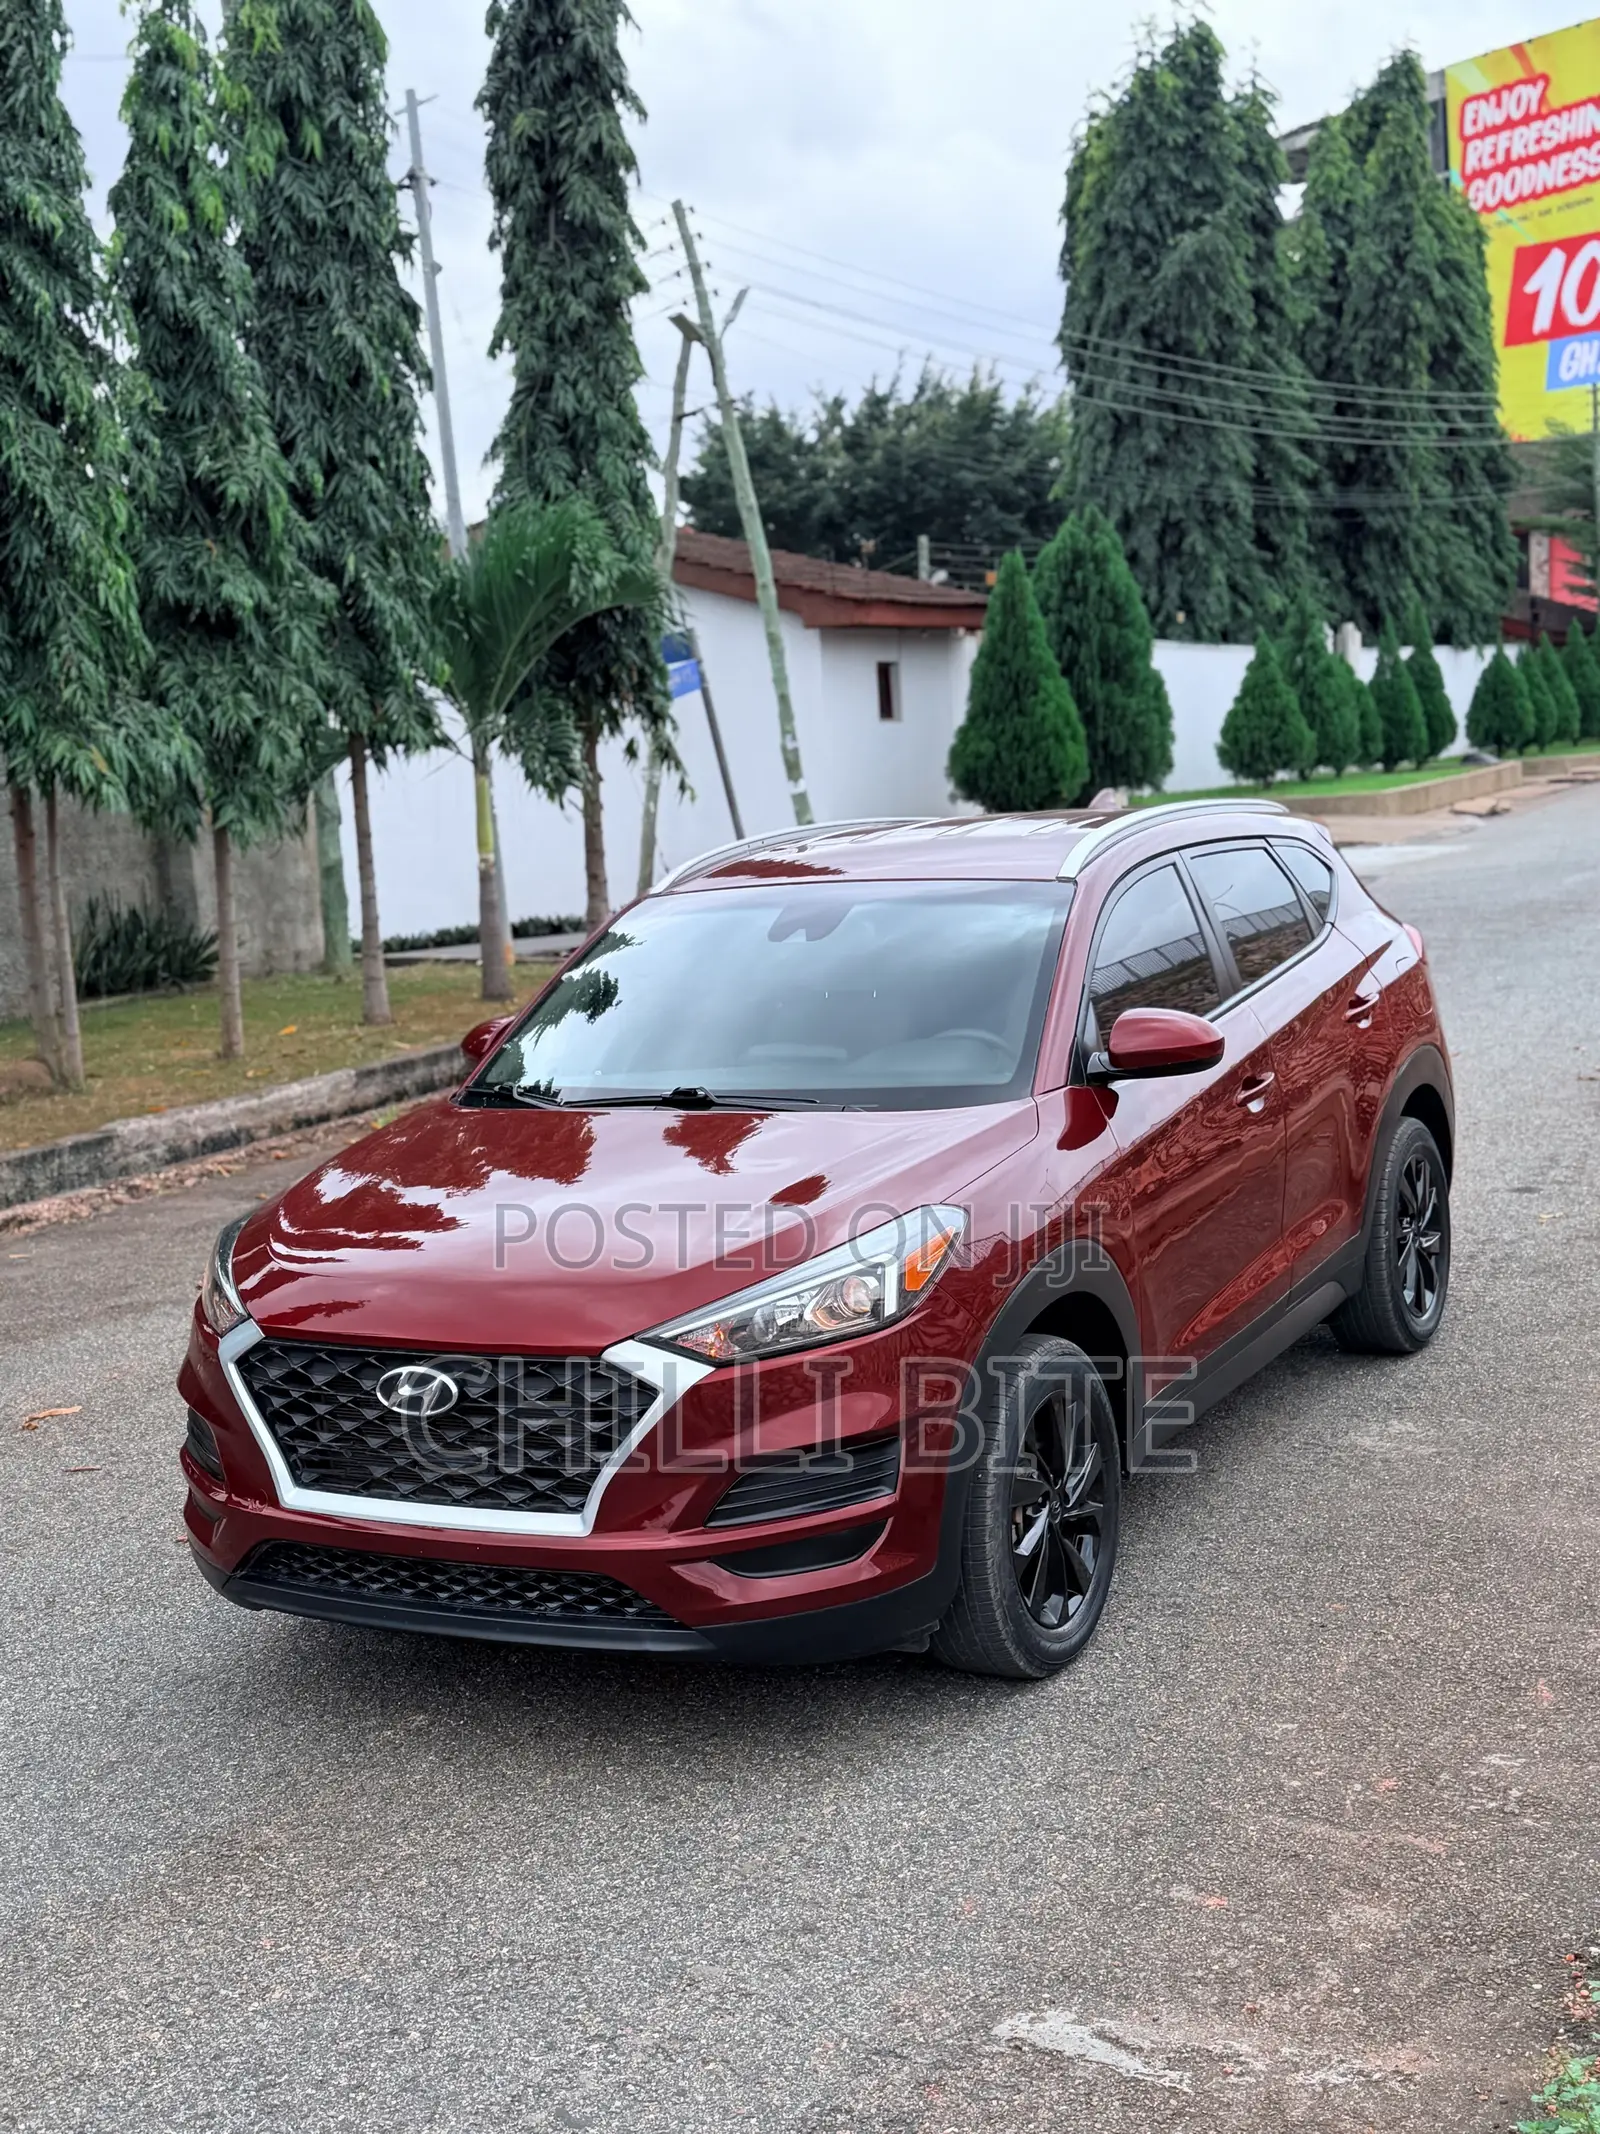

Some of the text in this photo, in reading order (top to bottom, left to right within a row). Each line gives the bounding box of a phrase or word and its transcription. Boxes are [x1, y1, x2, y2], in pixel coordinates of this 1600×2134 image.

[1463, 78, 1546, 137] ENJOY
[1468, 140, 1600, 211] GOODNESS
[1522, 239, 1600, 336] 10
[1558, 340, 1600, 382] GH
